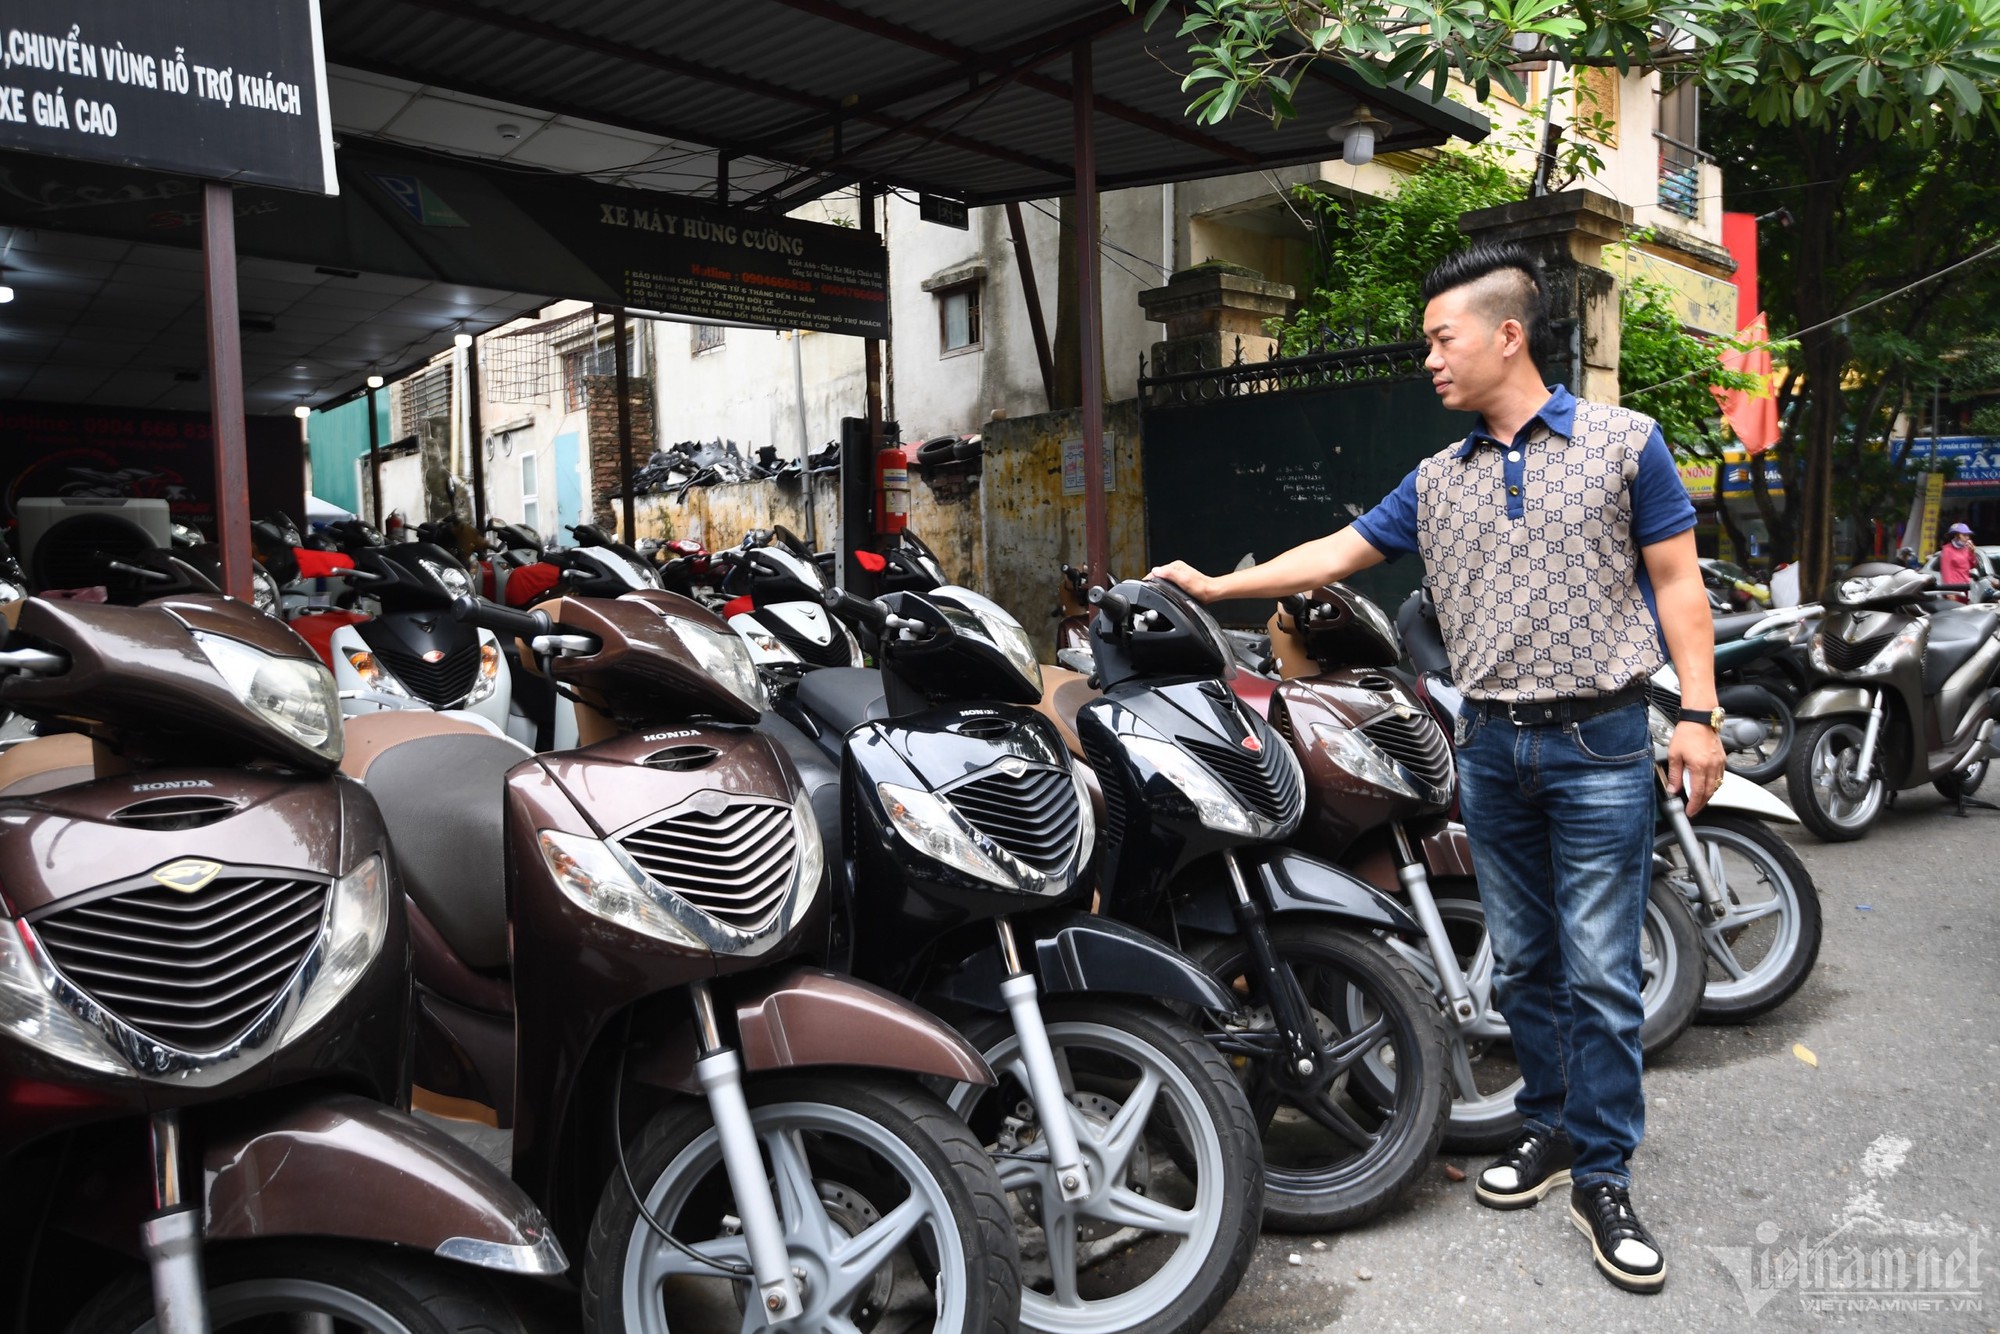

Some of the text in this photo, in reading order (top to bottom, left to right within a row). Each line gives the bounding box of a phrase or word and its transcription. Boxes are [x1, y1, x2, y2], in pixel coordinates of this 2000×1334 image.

[0, 23, 301, 115] ,CHUYỂN VÙNG HỖ TRỢ KHÁCH
[33, 86, 70, 129] GIÁ
[75, 98, 118, 137] CAO
[600, 203, 804, 256] XE MÁY HÙNG CƯỜNG
[690, 262, 734, 281] Hotline
[700, 281, 728, 291] LƯỢNG
[748, 288, 774, 298] THÁNG
[710, 308, 732, 317] TRAO
[713, 300, 734, 309] SANG
[812, 313, 831, 321] VÙNG
[858, 319, 882, 328] KHÁCH
[642, 729, 702, 742] HONDA
[132, 779, 214, 792] HONDA
